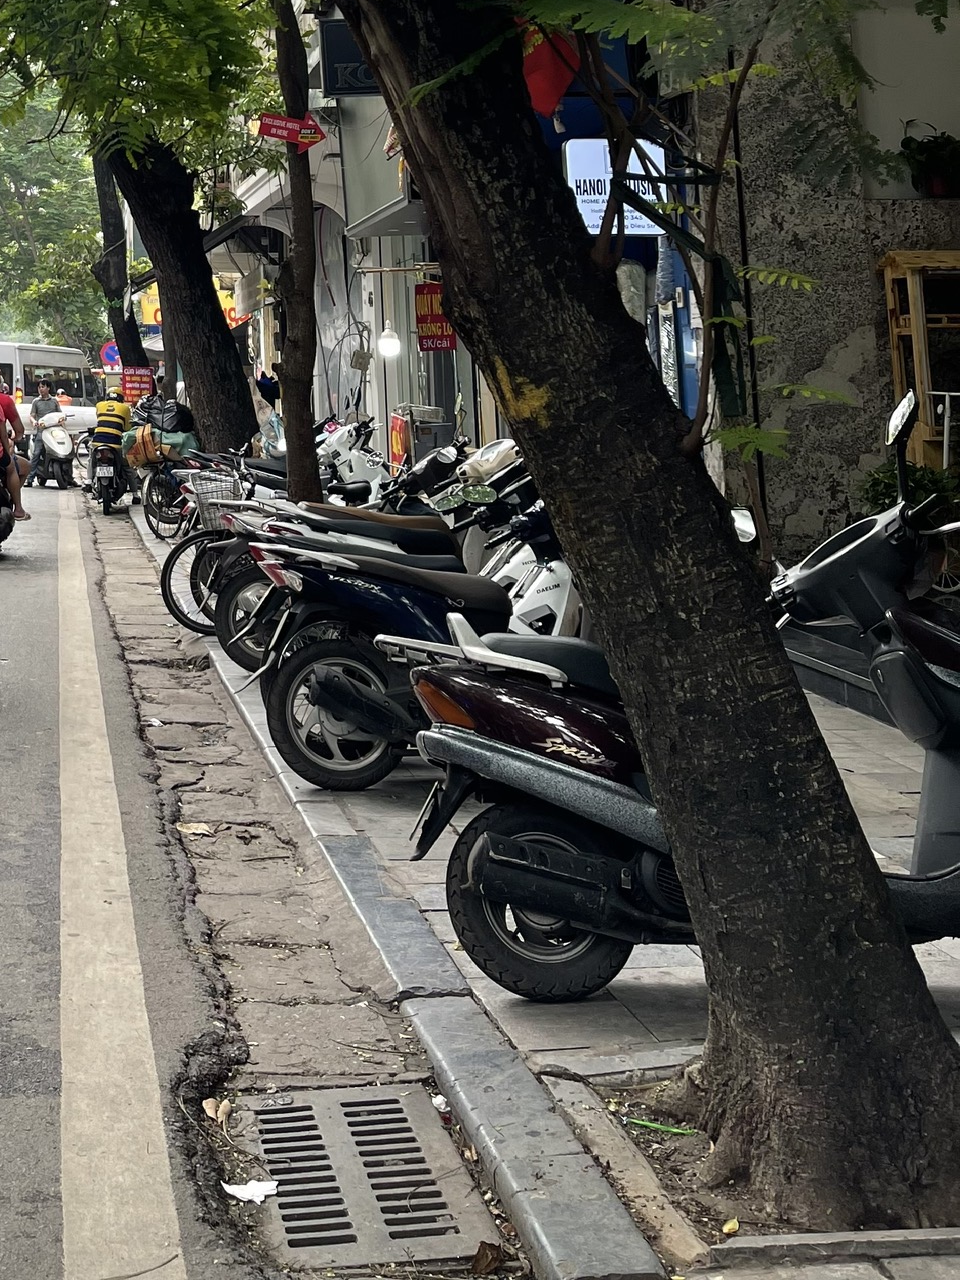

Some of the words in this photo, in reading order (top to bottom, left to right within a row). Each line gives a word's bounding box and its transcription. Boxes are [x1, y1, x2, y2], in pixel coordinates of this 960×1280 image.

[276, 128, 289, 136] HERE
[286, 122, 300, 130] HOTEL
[575, 178, 607, 196] HANOI
[422, 337, 451, 349] 5K/cái
[536, 583, 561, 595] DAELIM
